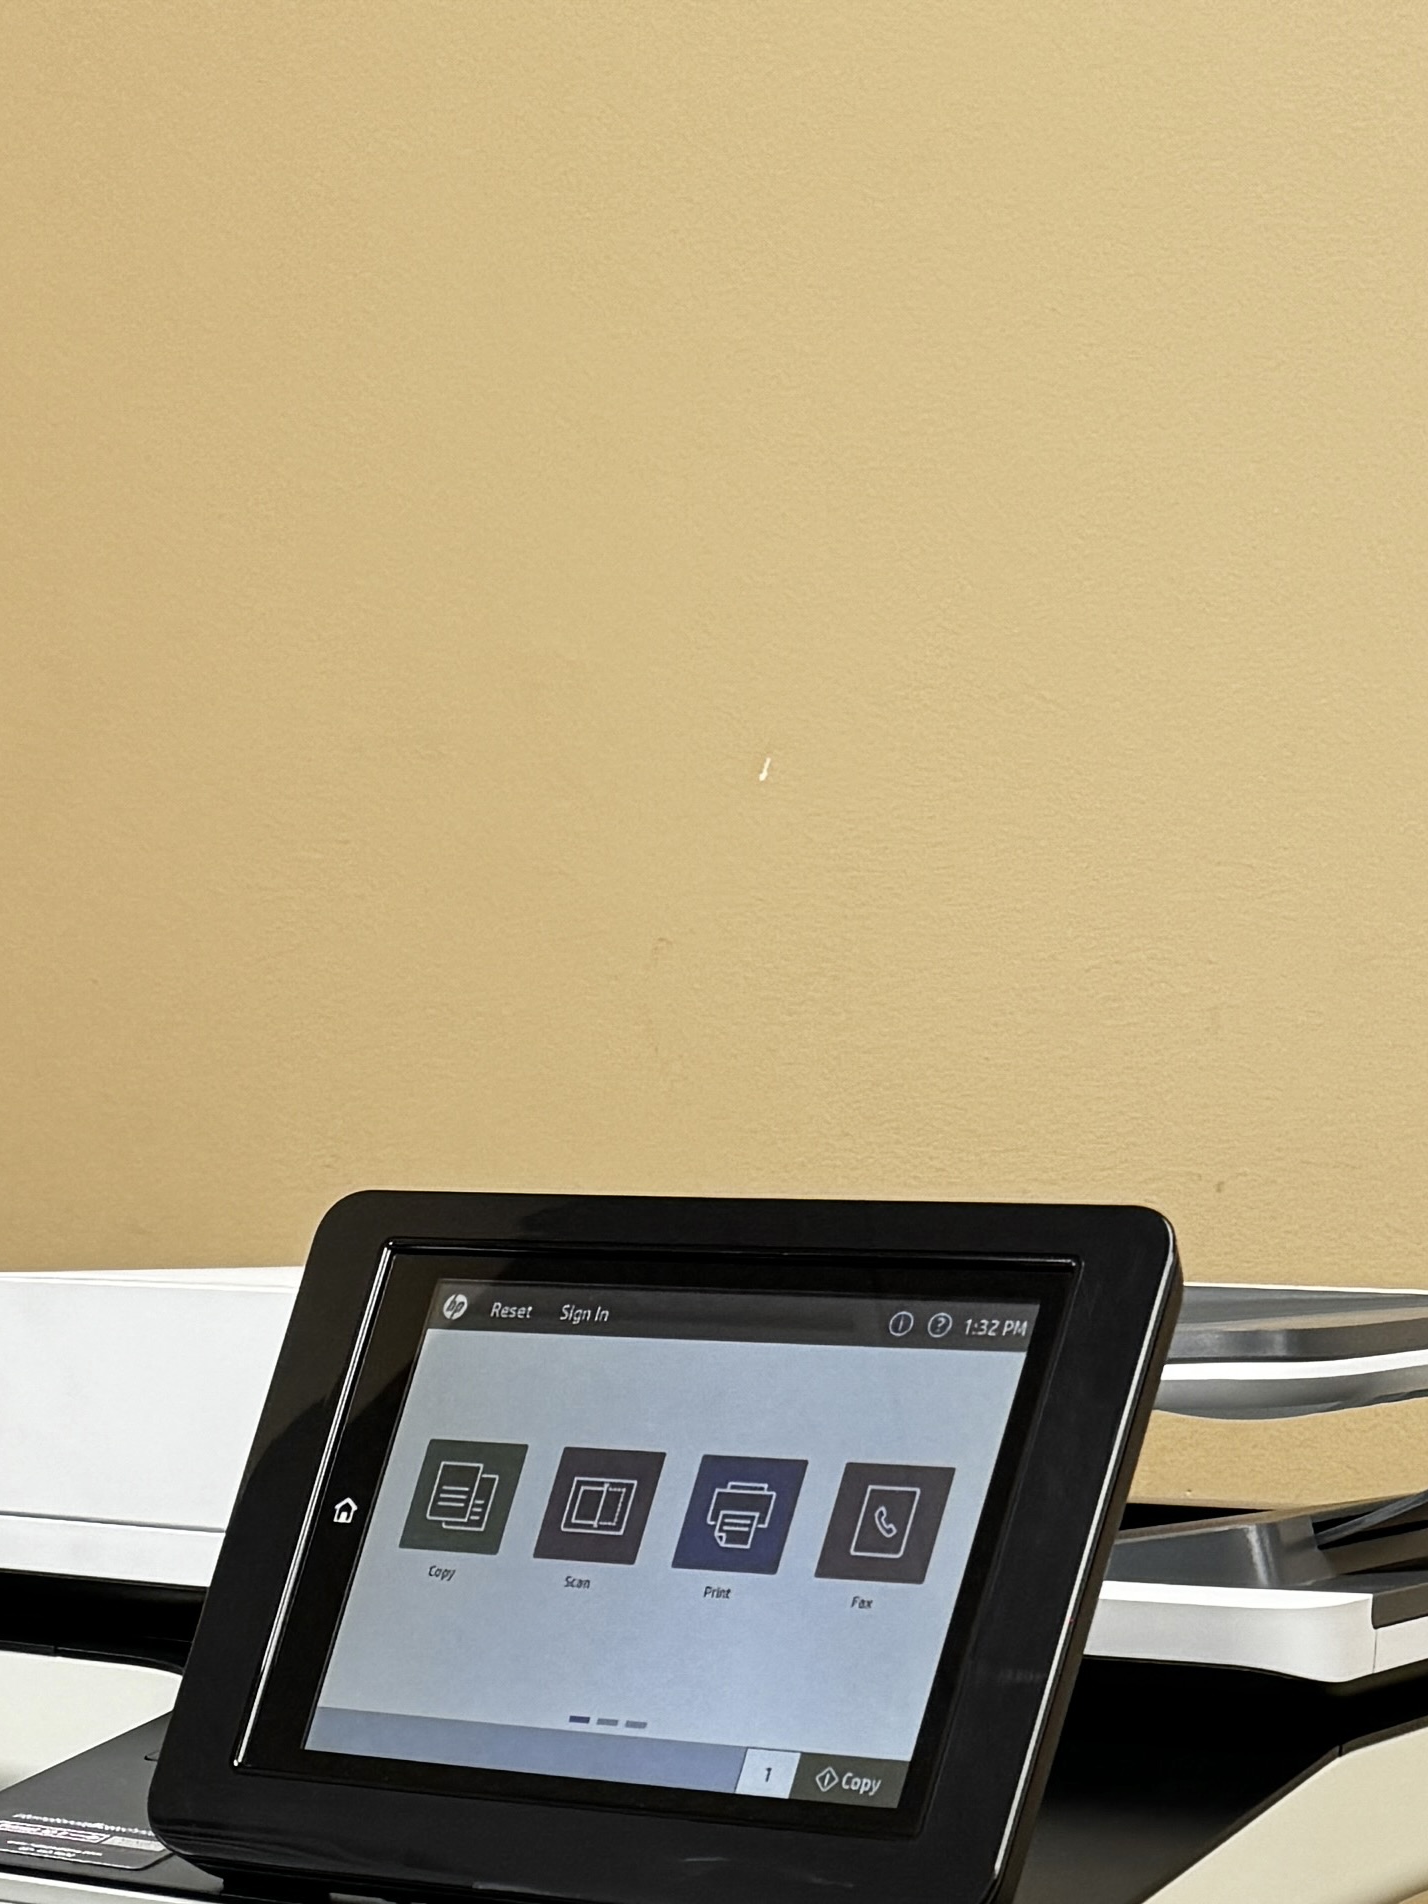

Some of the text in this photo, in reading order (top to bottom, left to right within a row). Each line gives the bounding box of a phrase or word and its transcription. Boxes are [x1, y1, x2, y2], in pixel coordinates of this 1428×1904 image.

[490, 1302, 533, 1319] Reset
[560, 1304, 610, 1325] Sign In
[965, 1318, 1028, 1337] 1:32 PM
[428, 1565, 456, 1581] Copy
[564, 1575, 591, 1589] Scan
[703, 1585, 732, 1599] Print
[850, 1595, 874, 1609] Fax
[764, 1767, 772, 1782] 1
[841, 1772, 882, 1796] Copy
